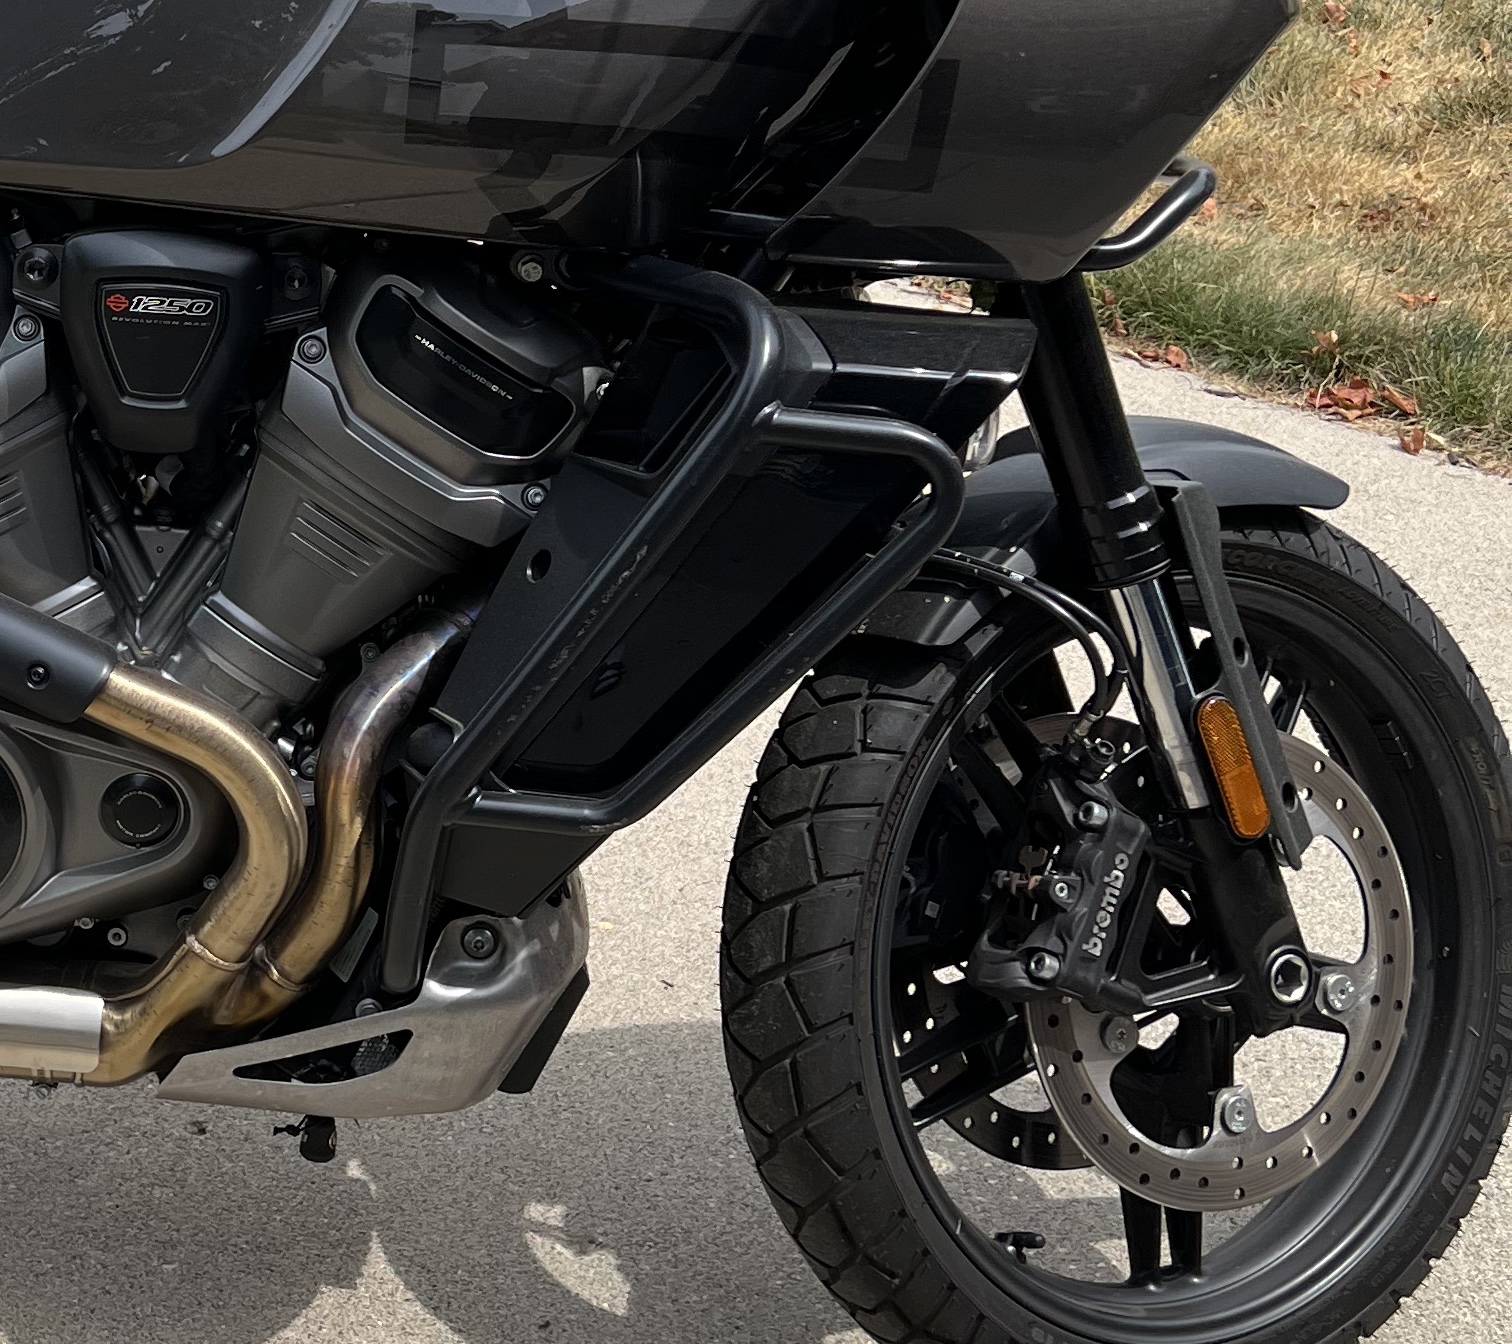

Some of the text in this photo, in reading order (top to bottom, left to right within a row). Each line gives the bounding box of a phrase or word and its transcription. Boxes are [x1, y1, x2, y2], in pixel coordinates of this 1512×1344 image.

[111, 316, 180, 326] REVOLUTION
[128, 295, 214, 316] 1250
[420, 338, 508, 397] HARLEY-DAVIDSON
[1081, 852, 1130, 957] brembo
[1441, 983, 1512, 1197] MICHELIN
